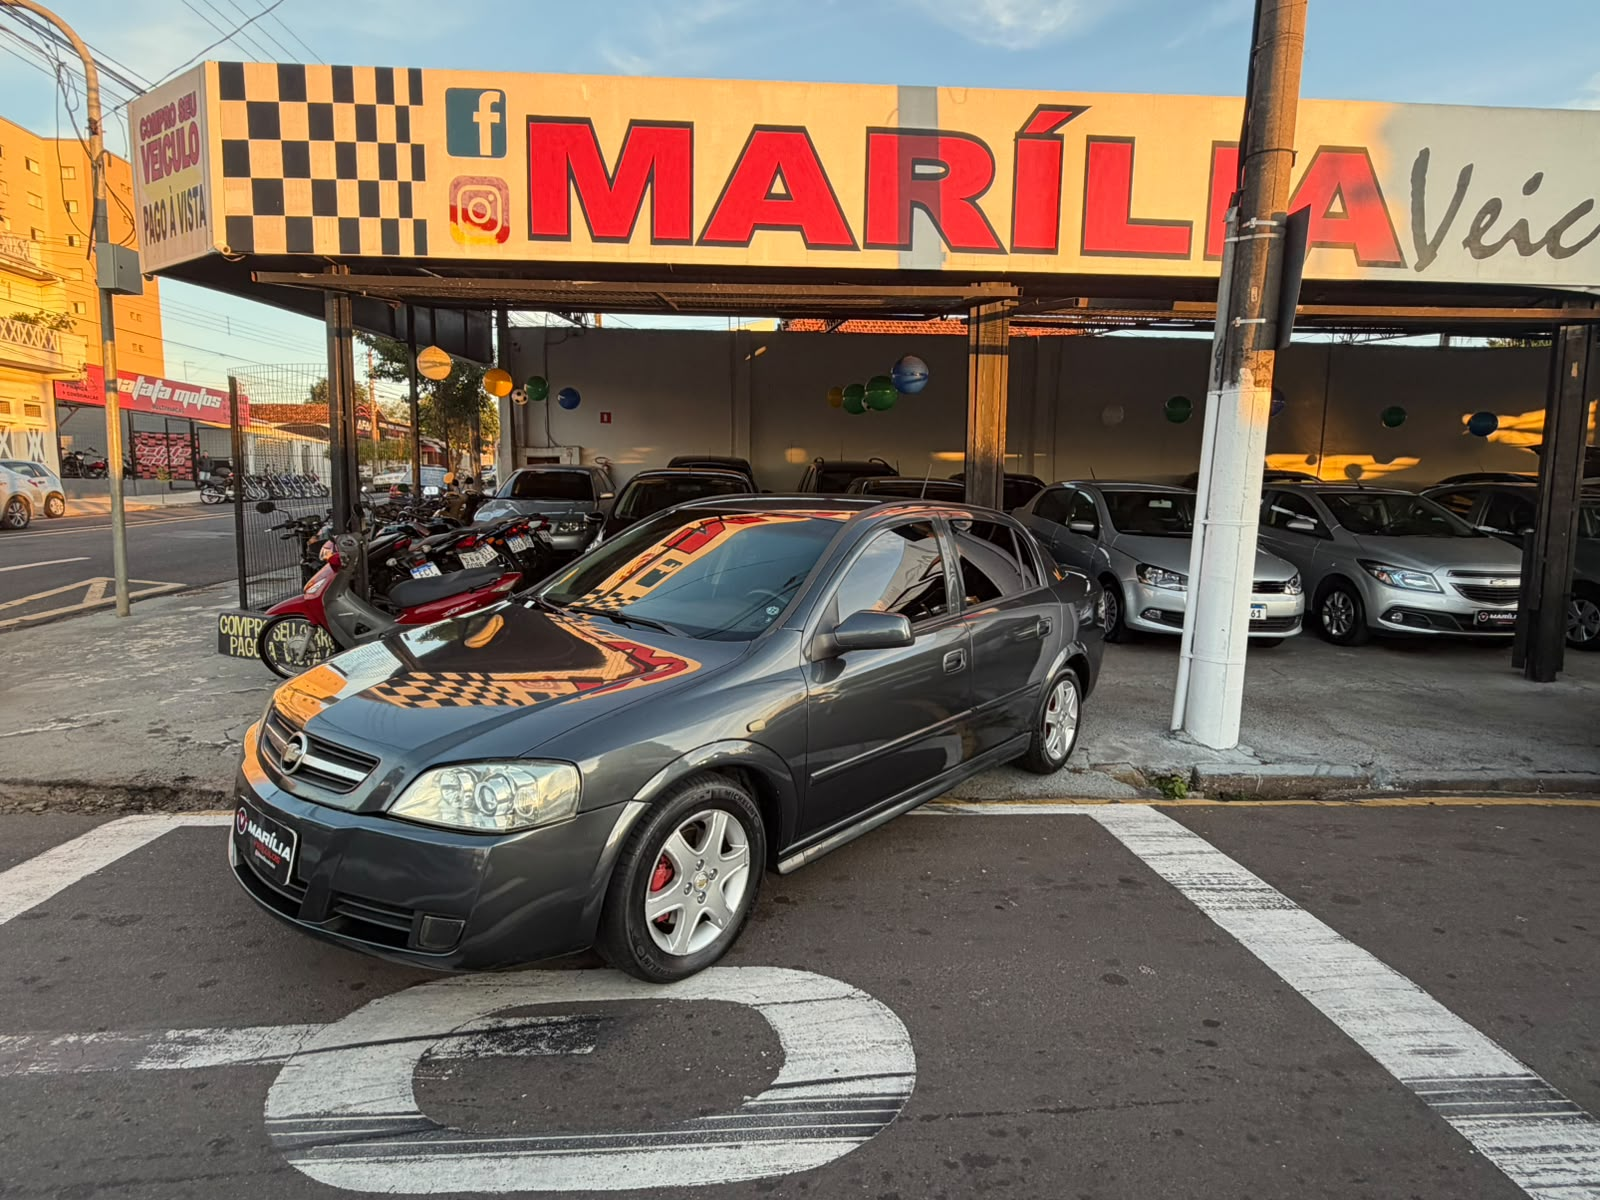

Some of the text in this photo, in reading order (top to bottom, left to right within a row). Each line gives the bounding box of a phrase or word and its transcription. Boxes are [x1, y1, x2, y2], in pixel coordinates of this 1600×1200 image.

[140, 91, 197, 141] COMPRO SEU
[143, 198, 167, 247] PAGO
[177, 184, 207, 234] VISTA
[117, 375, 172, 404] atata
[220, 614, 267, 637] COMPR
[1489, 612, 1518, 620] MARÍLI
[247, 819, 291, 862] MARÍLIA
